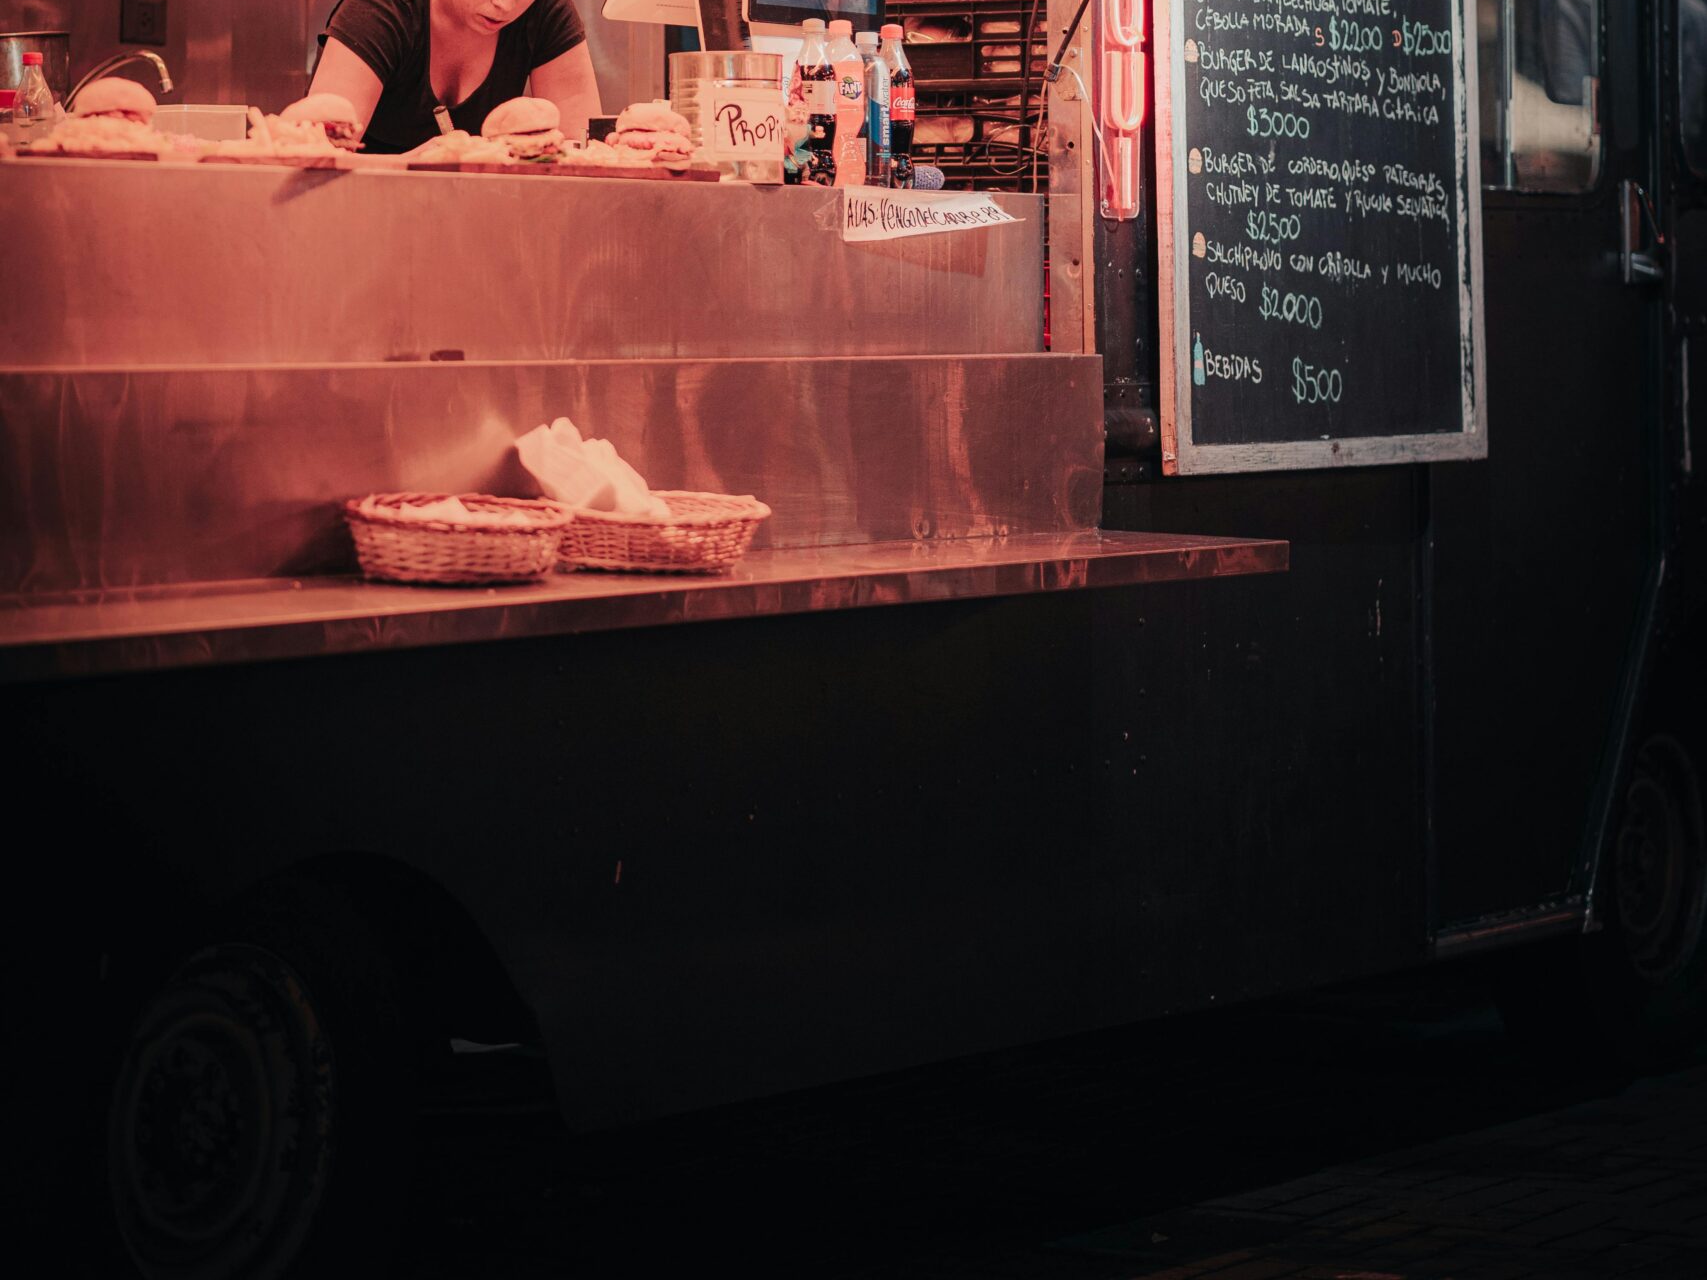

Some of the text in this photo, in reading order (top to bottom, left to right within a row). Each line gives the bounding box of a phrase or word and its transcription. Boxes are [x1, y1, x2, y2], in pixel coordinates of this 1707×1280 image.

[1195, 7, 1249, 31] CEBOLLA
[1252, 13, 1311, 38] MORADA
[1328, 16, 1383, 52] $2200
[1402, 15, 1452, 56] $2500
[1198, 40, 1257, 72] BURGER
[1258, 50, 1275, 73] DE
[1375, 67, 1386, 97] Y
[1200, 76, 1247, 107] QUESO
[1279, 80, 1321, 110] SALSA
[1323, 89, 1380, 119] TARTARA
[1246, 104, 1311, 140] $3000
[1202, 146, 1257, 178] BURGER
[1341, 160, 1376, 186] QUESO
[1206, 180, 1259, 207] CHUTNEY
[1265, 182, 1282, 204] DE
[1285, 185, 1337, 210] TOMATE
[1246, 209, 1301, 245] $2500
[1289, 253, 1314, 273] CON
[1318, 251, 1372, 279] CRIOLLA
[1397, 262, 1442, 290] MUCHO
[1205, 271, 1323, 329] QUESO $2000
[1203, 348, 1343, 404] BEBIDAS $500
